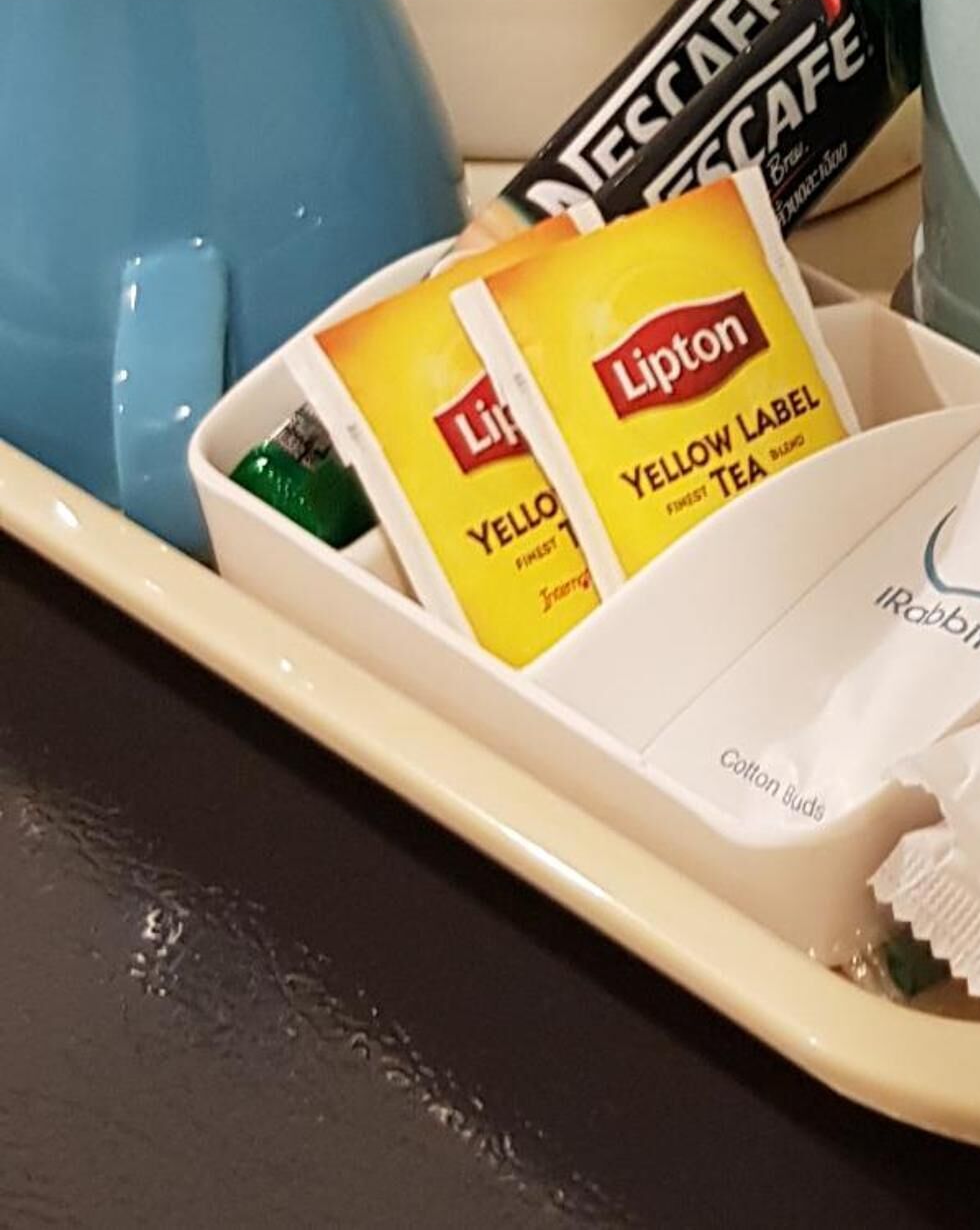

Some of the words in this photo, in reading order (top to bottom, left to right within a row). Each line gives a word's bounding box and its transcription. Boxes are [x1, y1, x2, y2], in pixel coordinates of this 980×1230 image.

[612, 313, 749, 401] Lipton
[620, 423, 733, 500] YELLOW
[736, 385, 821, 444] LABEL
[666, 485, 709, 516] FINEST
[709, 454, 769, 498] TEA
[768, 434, 806, 461] BLEND
[466, 488, 560, 556] YELLO
[515, 536, 558, 570] FINEST
[720, 748, 781, 797] Cotton
[782, 783, 826, 822] Buds
